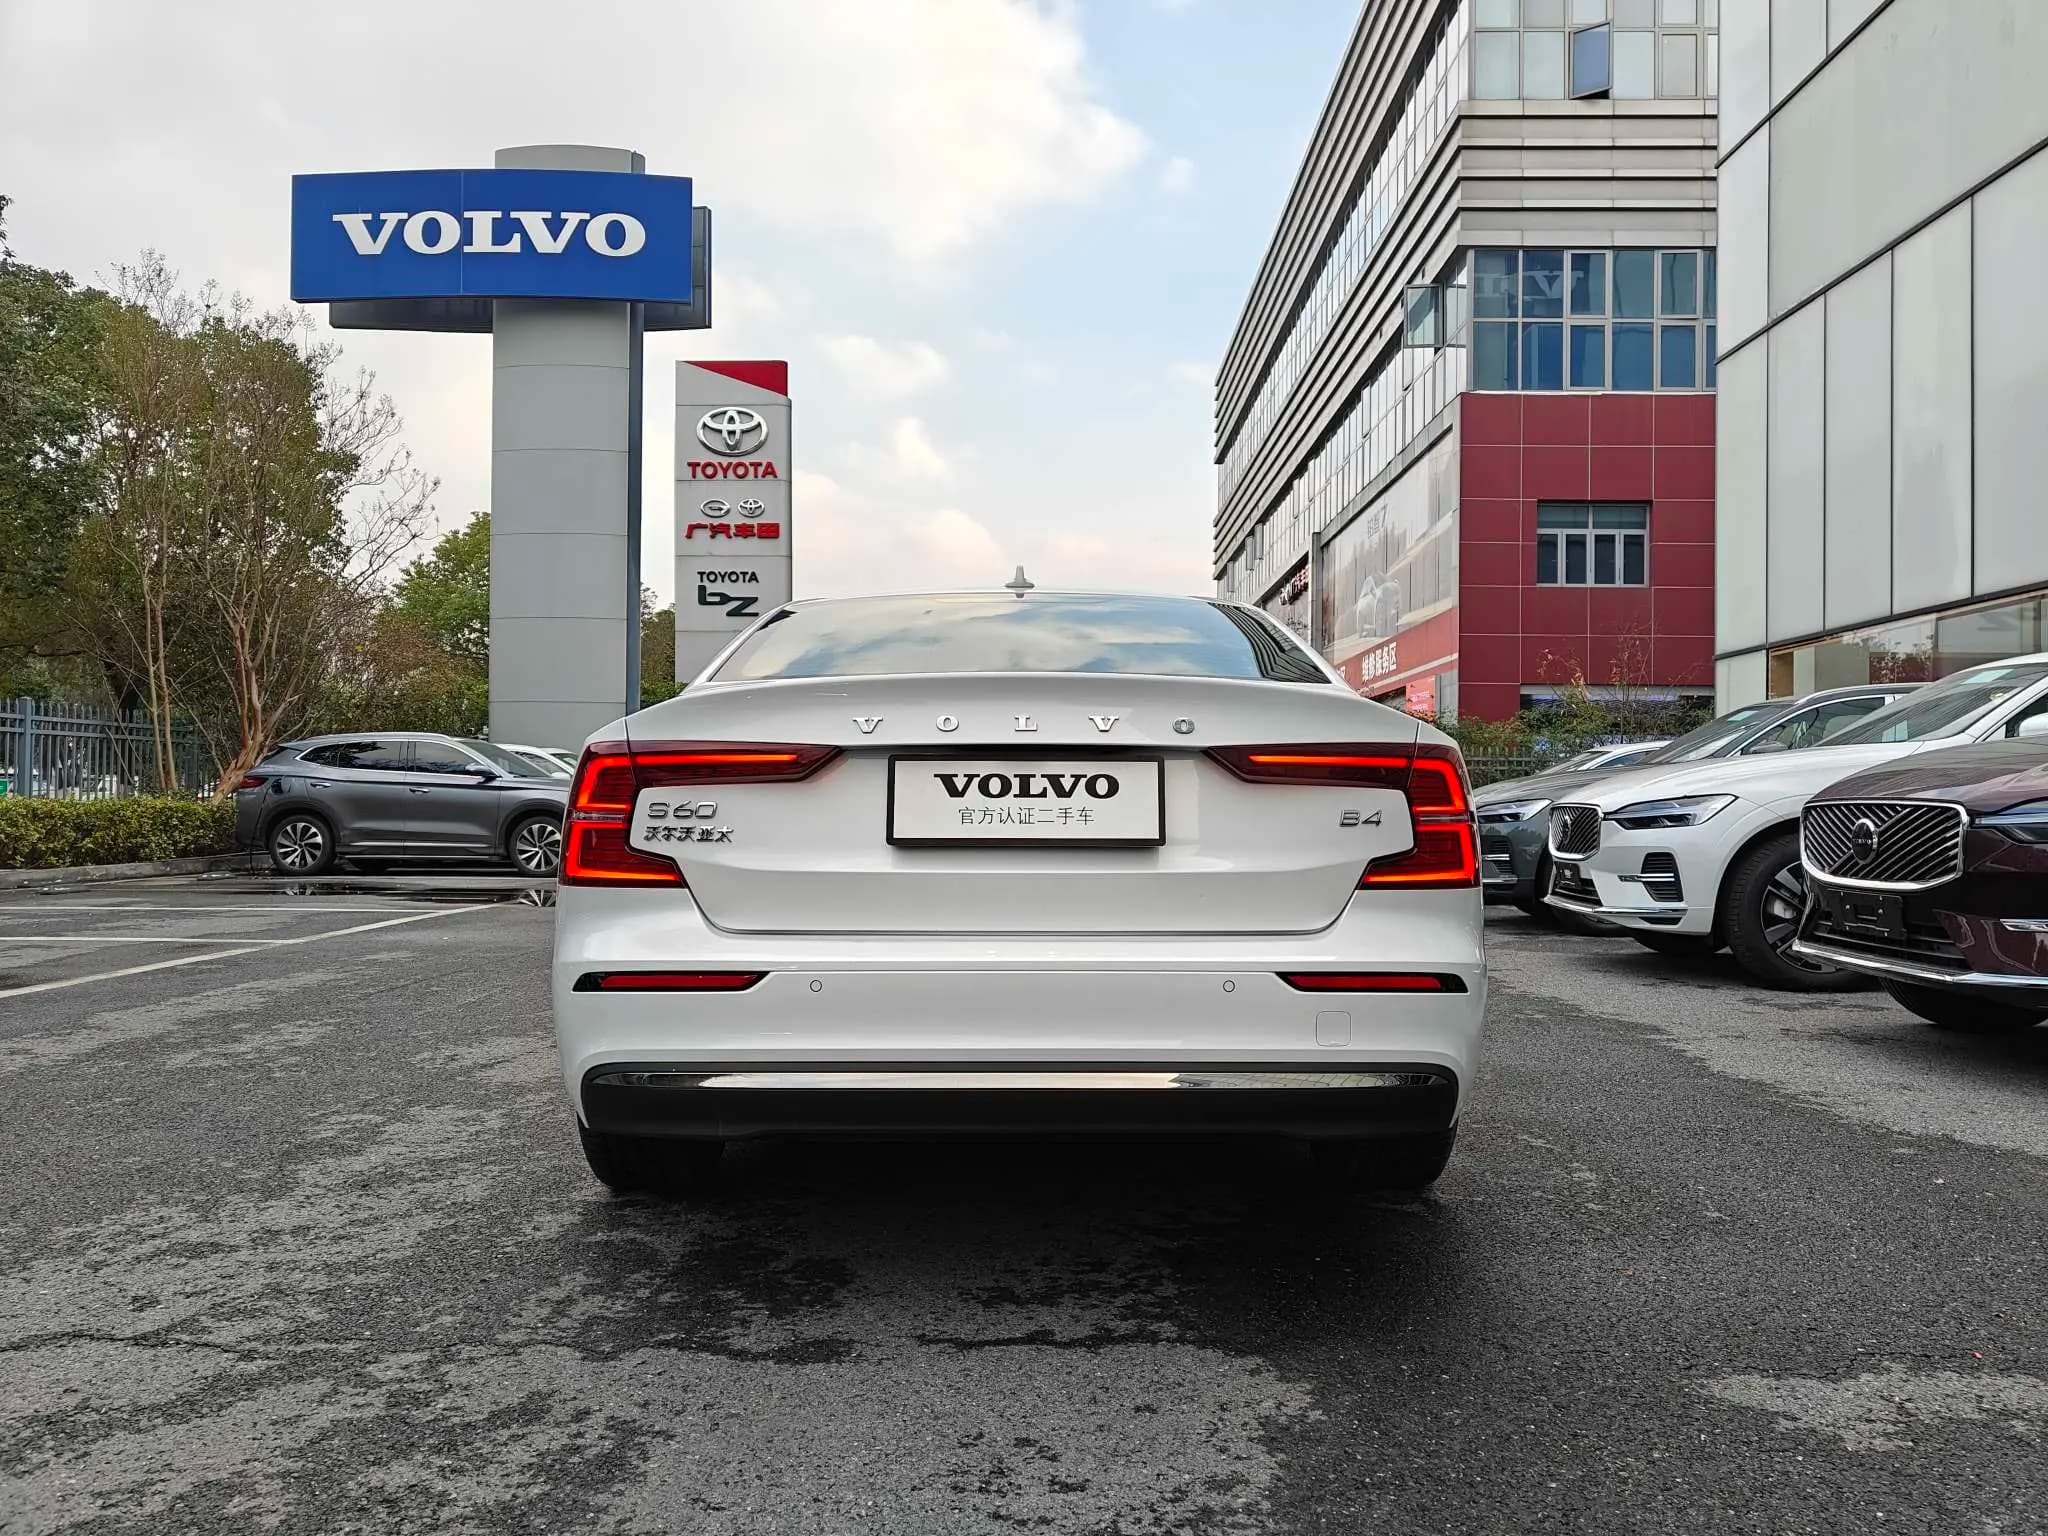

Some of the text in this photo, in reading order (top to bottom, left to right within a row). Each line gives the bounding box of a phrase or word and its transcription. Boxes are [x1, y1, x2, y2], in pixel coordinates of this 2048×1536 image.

[332, 210, 646, 257] VOLVO
[687, 461, 778, 479] TOYOTA
[697, 571, 760, 584] TOYOTA
[1361, 641, 1398, 683] 维修服务区
[852, 714, 1197, 735] VOLVO
[933, 773, 1121, 800] VOLVO
[648, 800, 718, 819] S60
[958, 806, 1096, 825] 官方认证二手车
[1339, 809, 1383, 828] B4
